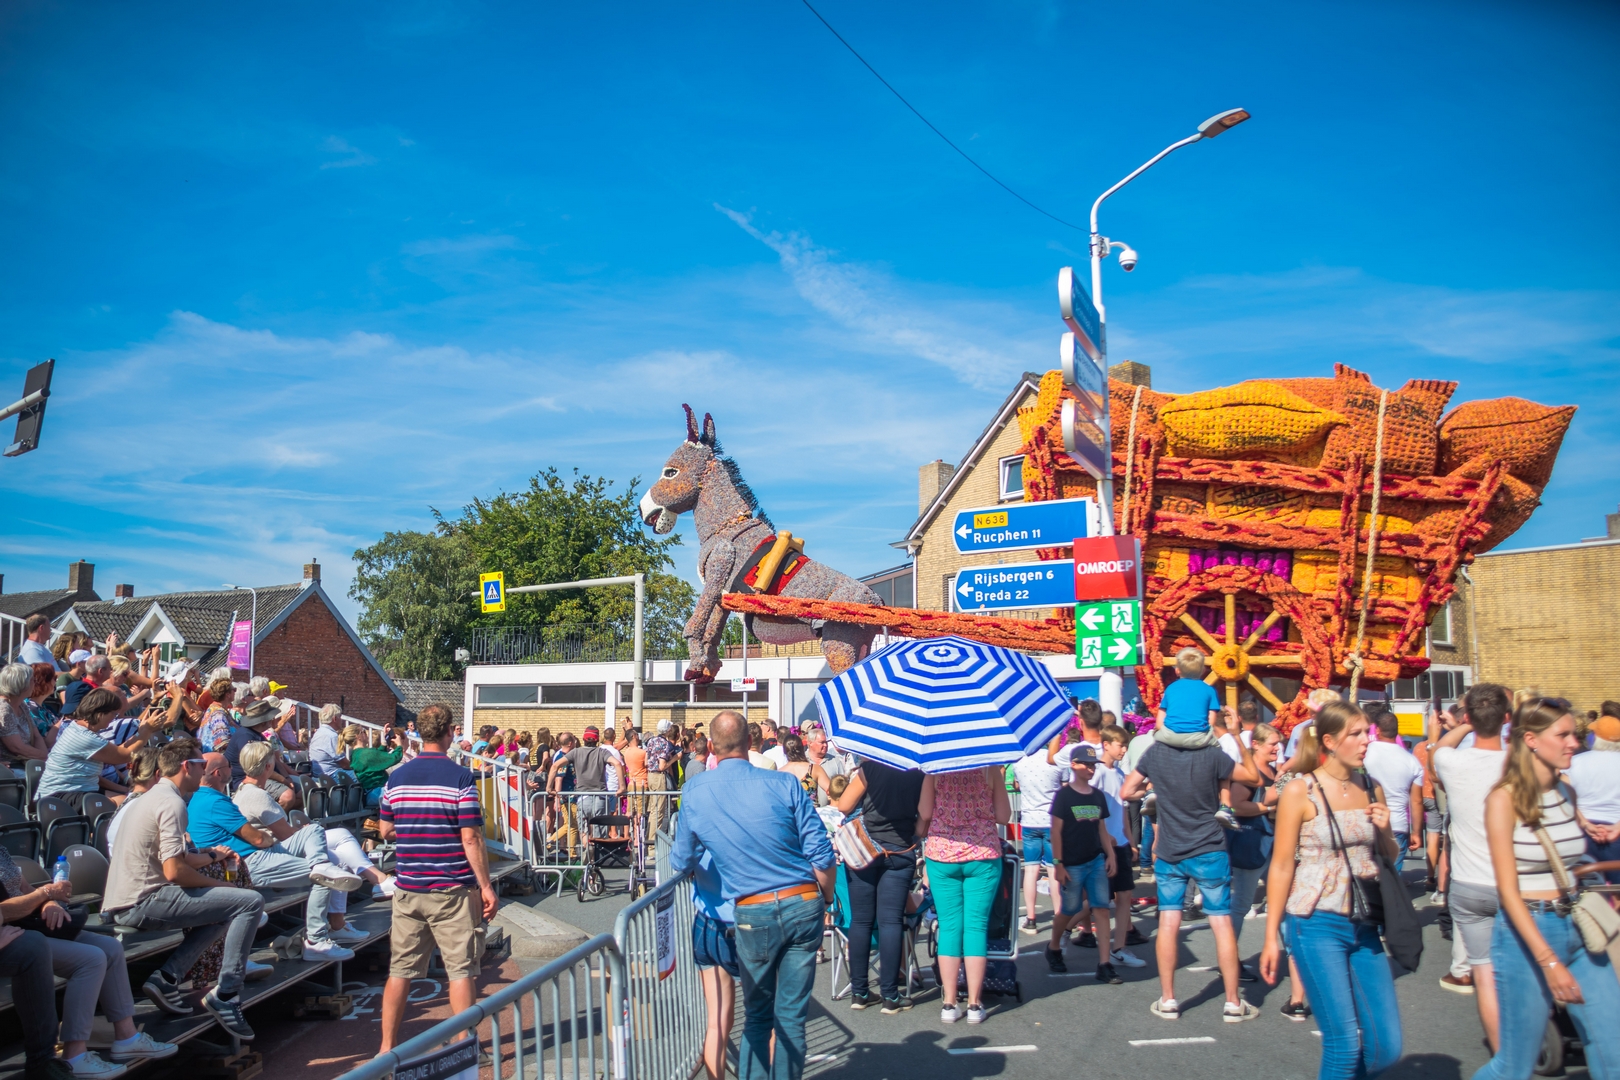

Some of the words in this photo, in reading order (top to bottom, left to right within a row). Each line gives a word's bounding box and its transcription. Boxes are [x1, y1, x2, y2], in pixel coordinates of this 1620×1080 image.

[976, 517, 983, 526] N
[985, 514, 1005, 525] 638
[973, 529, 1028, 543] Rucphen
[1032, 529, 1041, 538] 11
[1077, 560, 1134, 575] OMROEP
[974, 571, 1043, 587] Rijsbergen
[1046, 570, 1054, 579] 6
[975, 589, 1012, 602] Breda
[1015, 589, 1029, 599] 22
